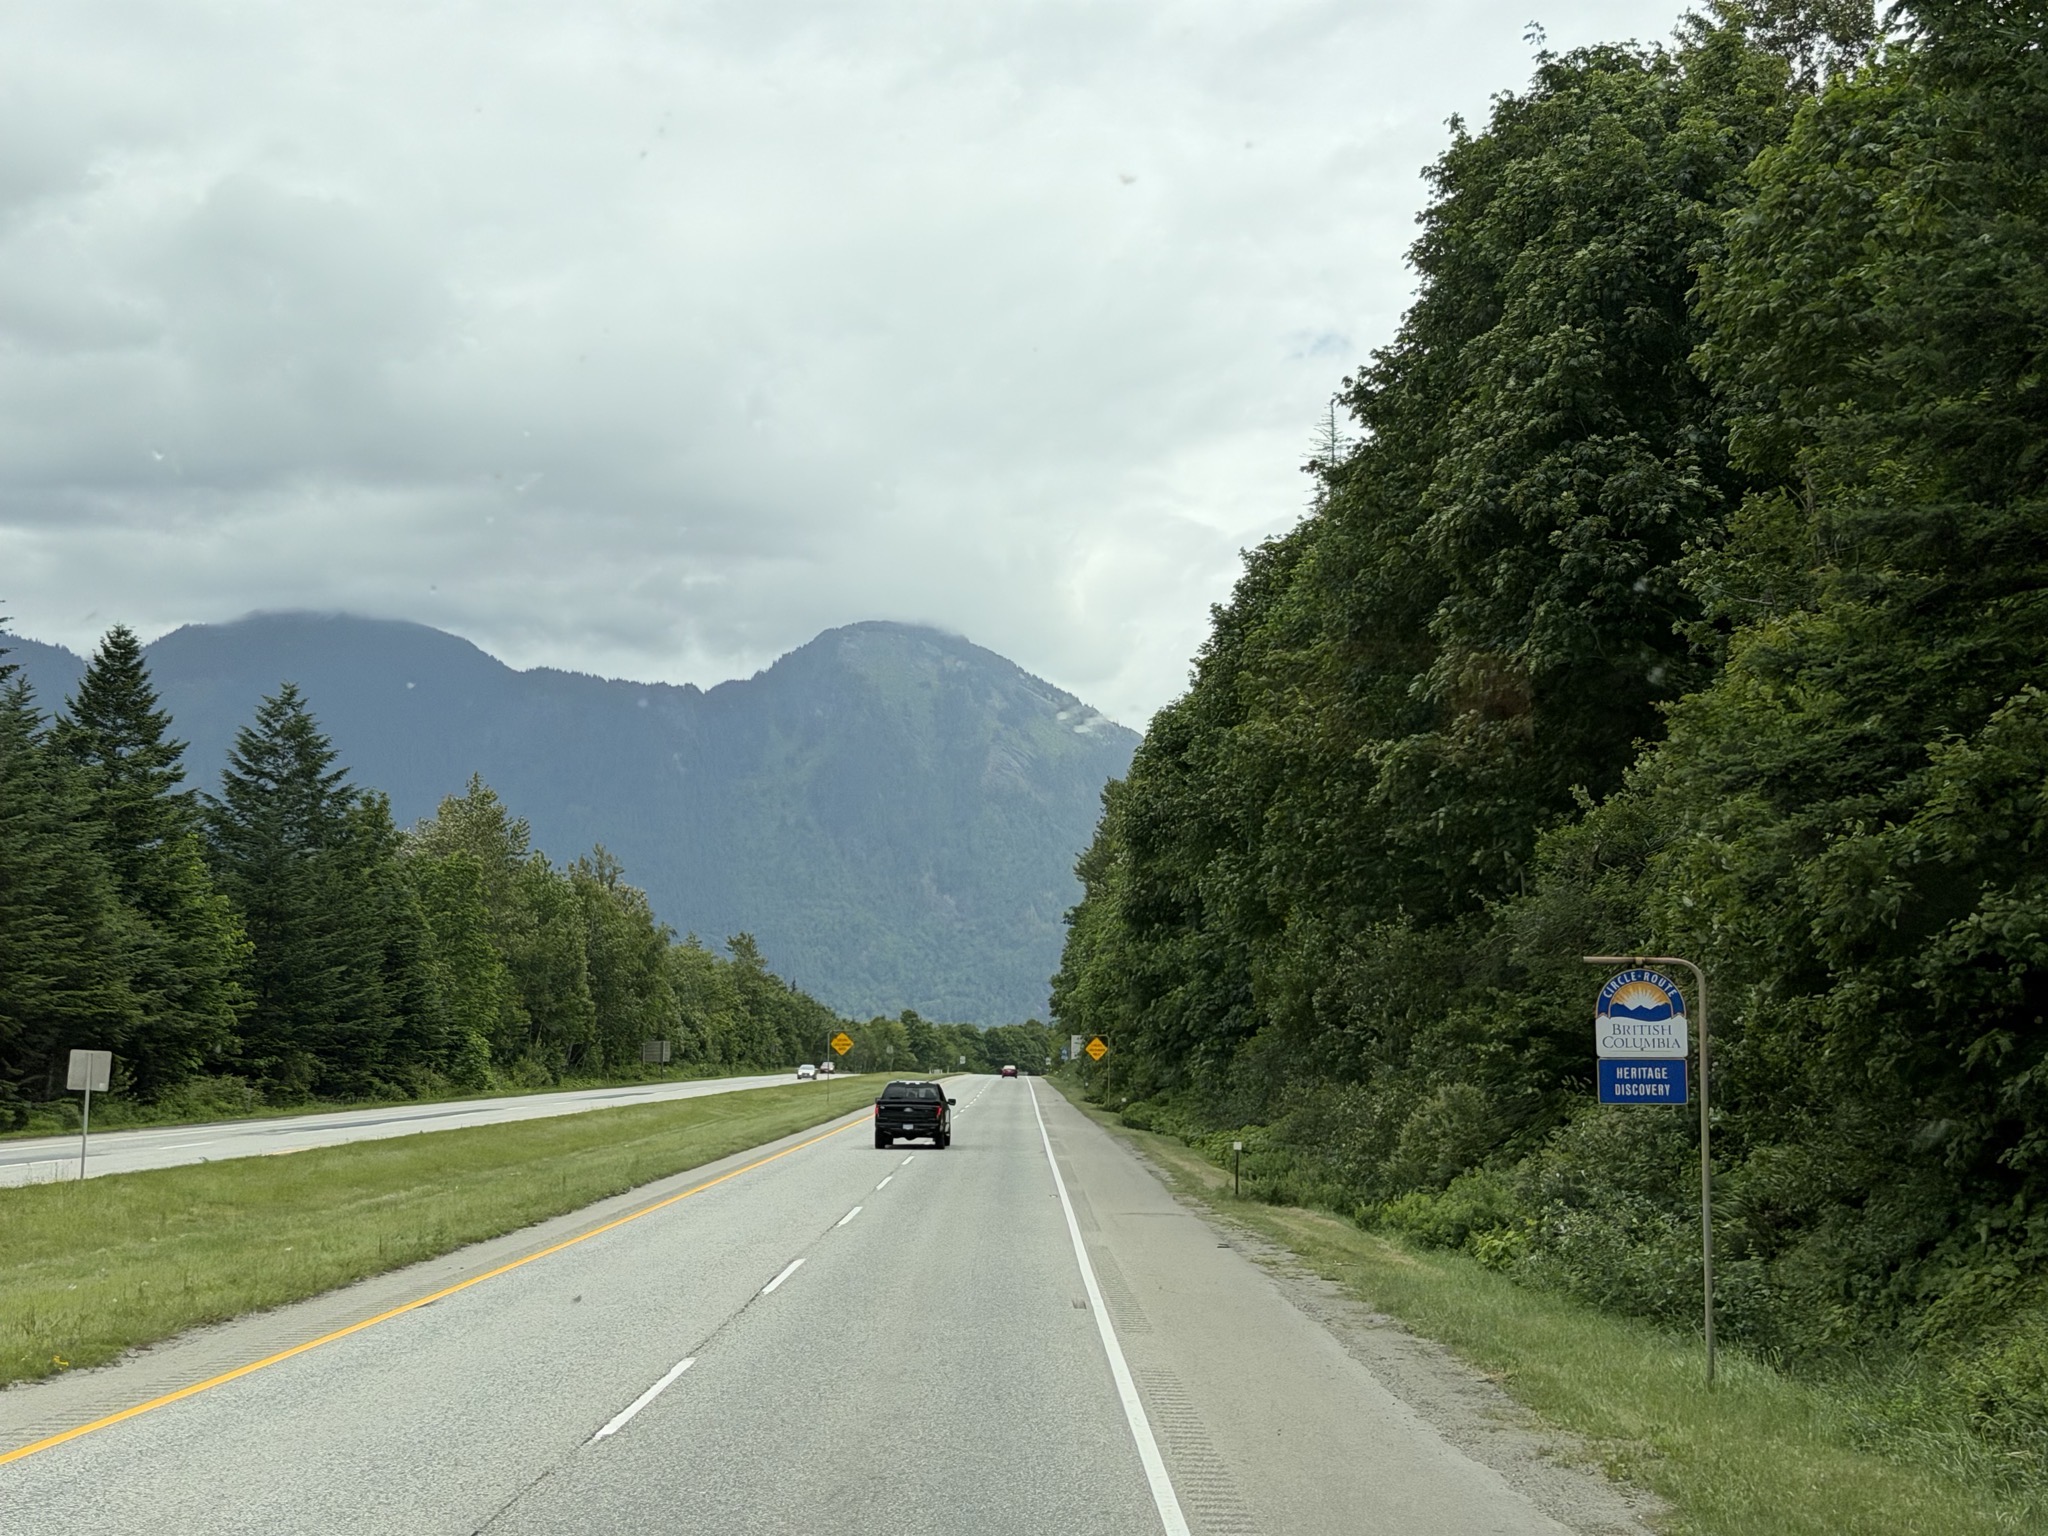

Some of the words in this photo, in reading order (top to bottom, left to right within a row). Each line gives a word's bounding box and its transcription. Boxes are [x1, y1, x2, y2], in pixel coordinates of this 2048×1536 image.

[1603, 971, 1637, 998] CIRCLE
[1643, 971, 1678, 998] ROUTE
[1612, 1023, 1672, 1036] BRITISH
[1602, 1035, 1681, 1049] COLUMBIA
[1616, 1067, 1668, 1079] HERITAGE
[1614, 1083, 1671, 1096] DISCOVERY
